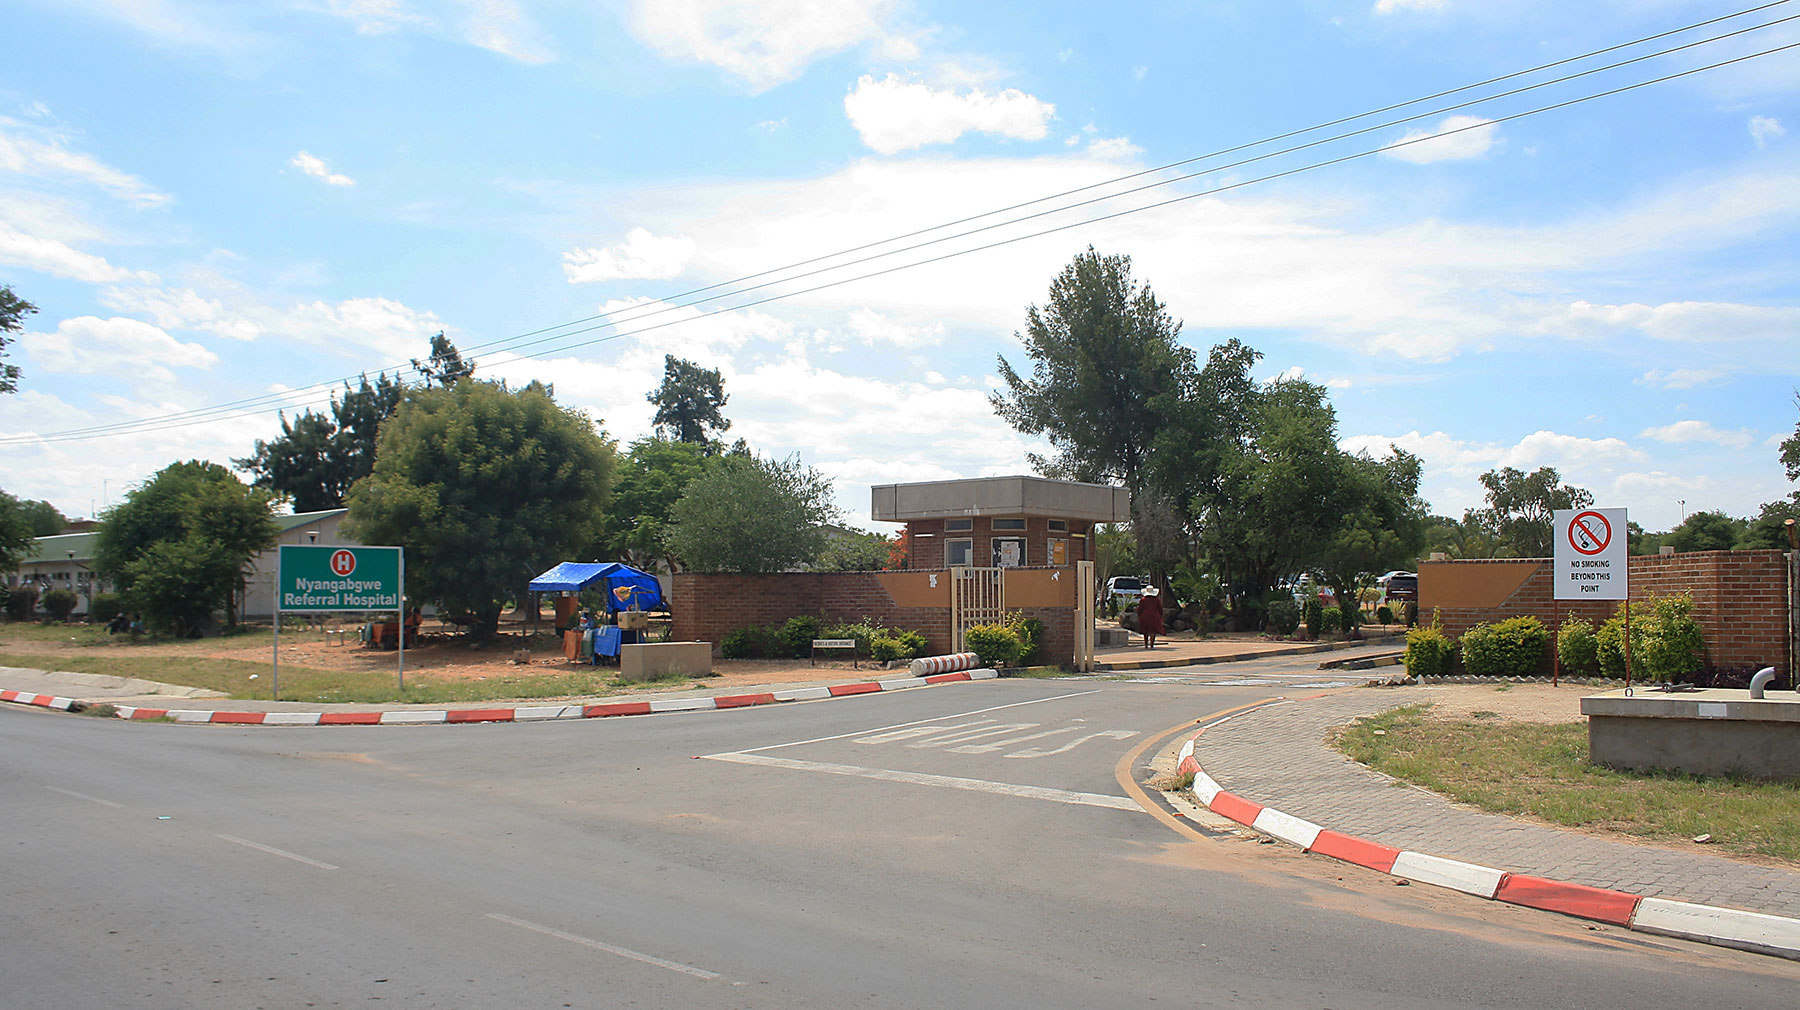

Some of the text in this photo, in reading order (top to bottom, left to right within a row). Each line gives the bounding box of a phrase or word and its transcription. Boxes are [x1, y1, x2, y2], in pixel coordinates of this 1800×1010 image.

[337, 554, 351, 571] H
[1570, 560, 1610, 568] NO SMOKING
[296, 578, 382, 593] Nyangabgwe
[284, 593, 397, 608] Referral Hospital
[851, 719, 1141, 758] STOP
